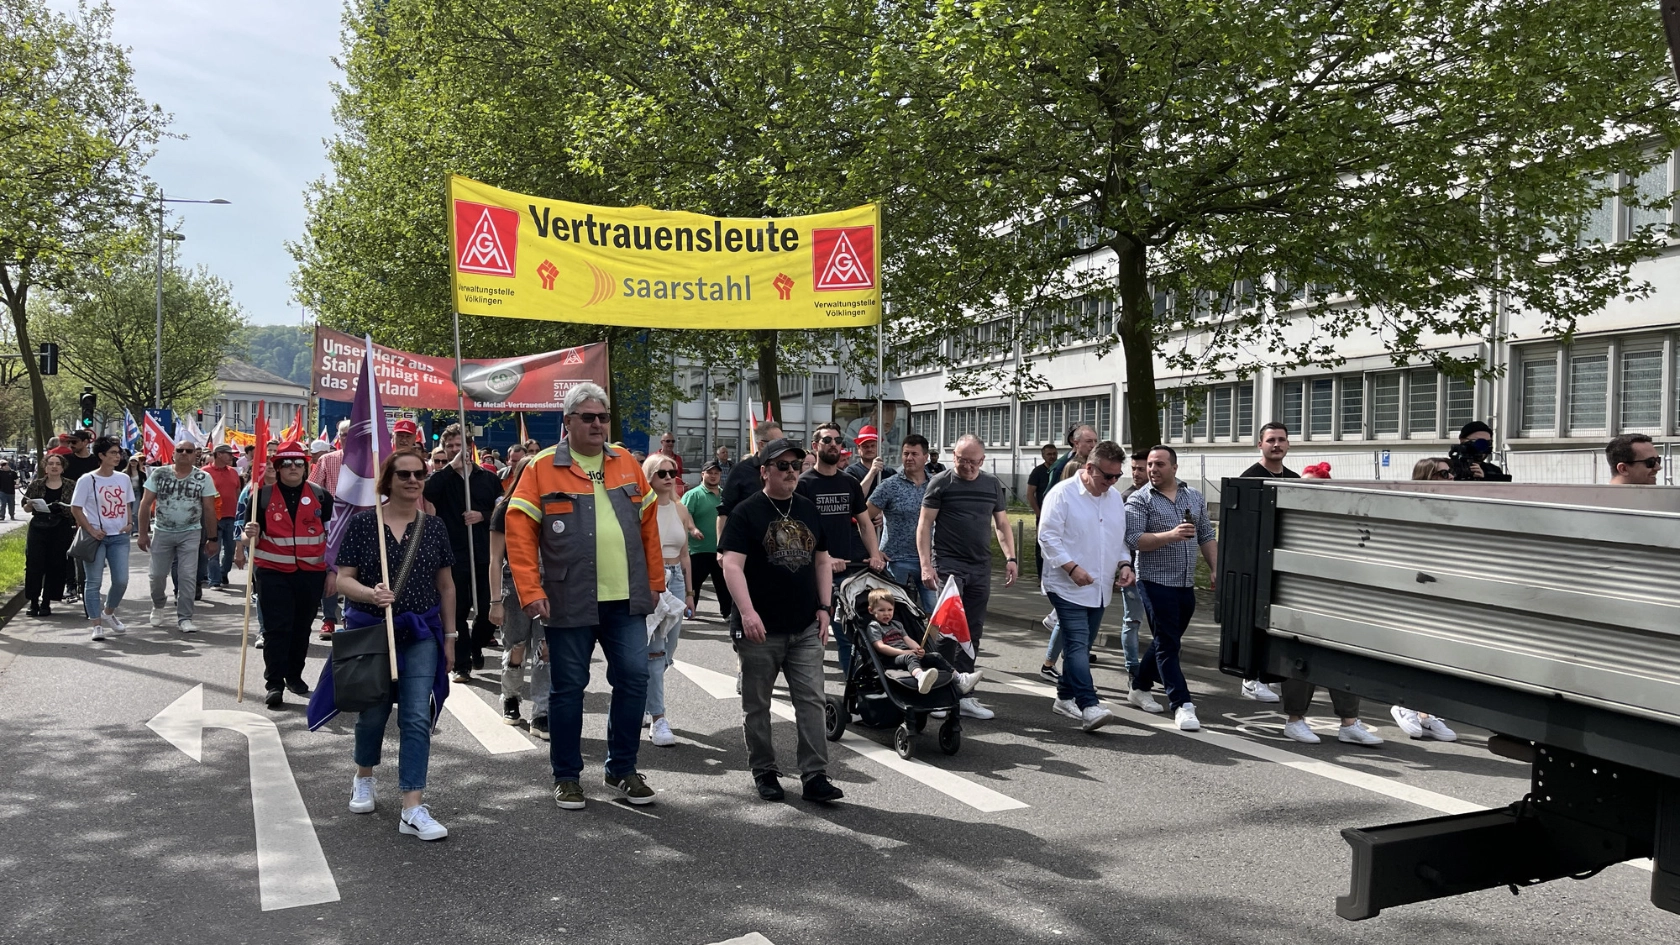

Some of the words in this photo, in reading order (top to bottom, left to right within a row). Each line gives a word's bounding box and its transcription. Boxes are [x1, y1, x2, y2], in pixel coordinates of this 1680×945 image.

[528, 204, 799, 252] Vertrauensleute
[464, 294, 503, 306] Völklingen
[623, 274, 751, 301] saarstahl
[826, 309, 866, 317] Völklingen
[323, 338, 367, 357] Unser
[372, 348, 405, 366] Herz
[408, 359, 435, 373] aus
[322, 355, 360, 375] Stahl
[372, 362, 420, 383] chlägt
[423, 372, 445, 386] für
[321, 373, 348, 390] das
[352, 376, 419, 397] Srland
[816, 496, 840, 505] STAHL
